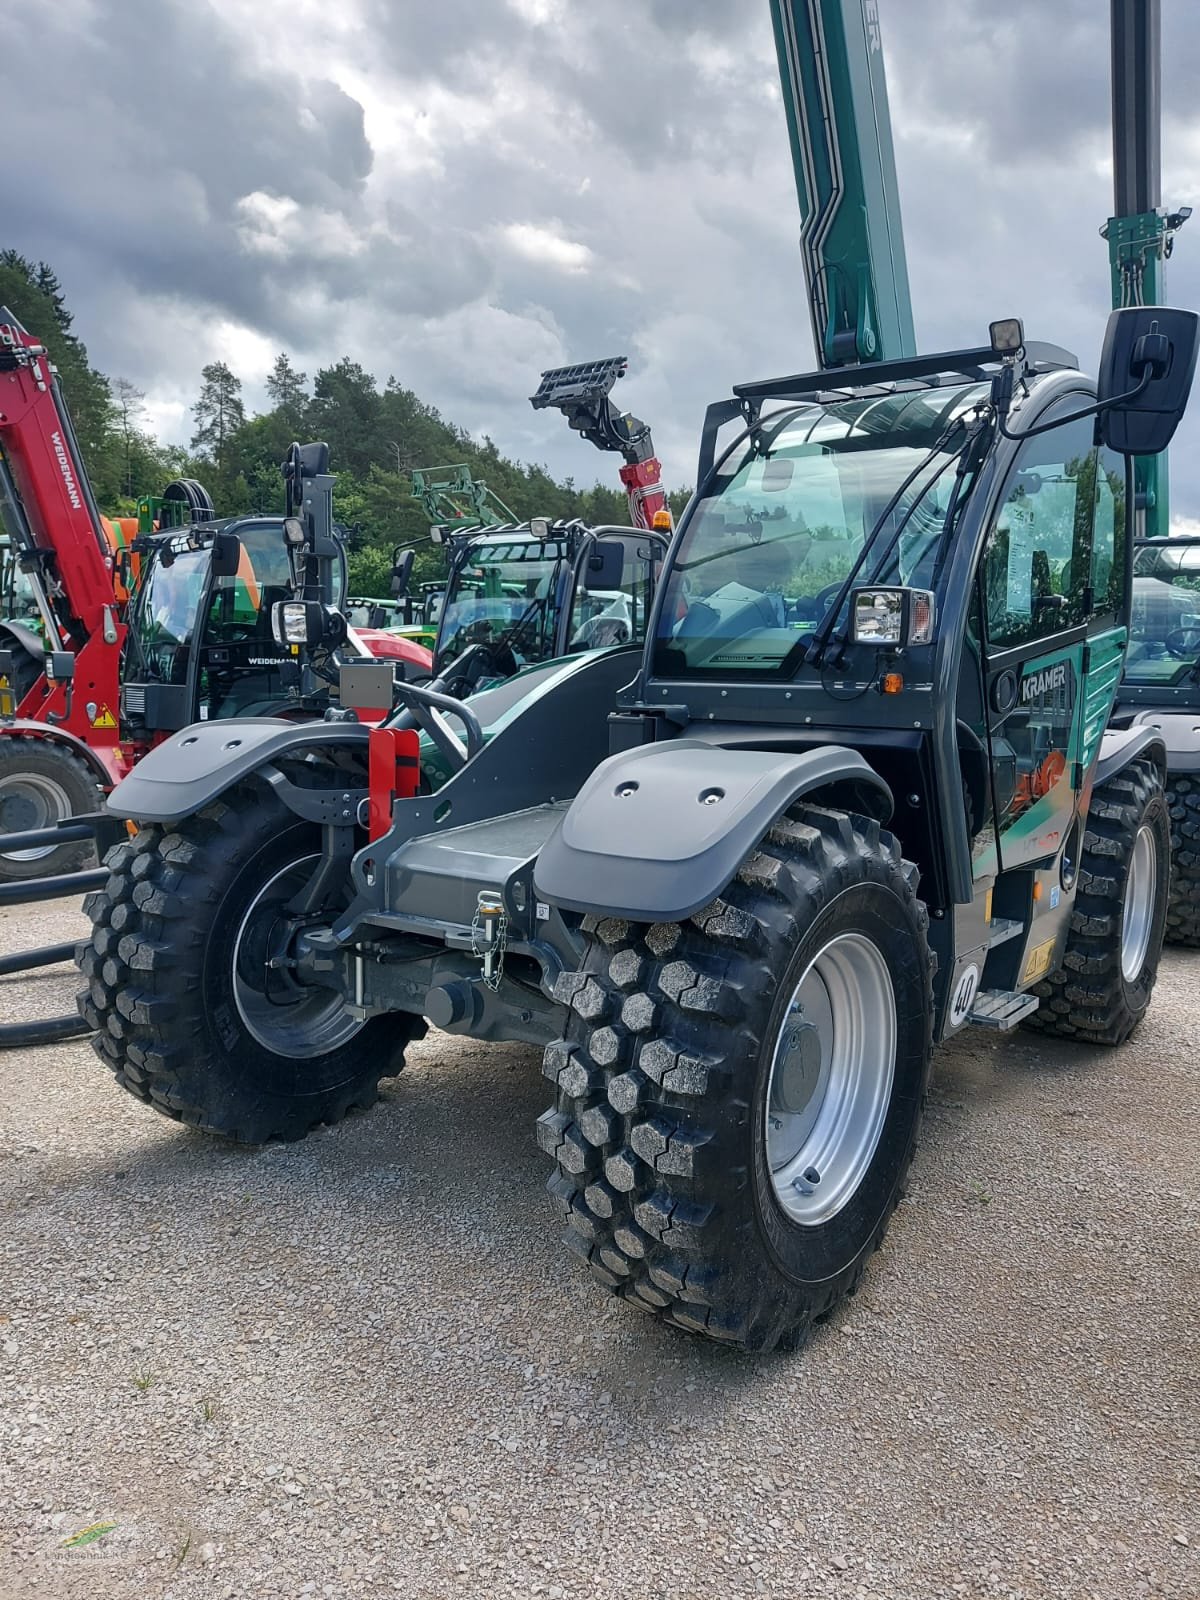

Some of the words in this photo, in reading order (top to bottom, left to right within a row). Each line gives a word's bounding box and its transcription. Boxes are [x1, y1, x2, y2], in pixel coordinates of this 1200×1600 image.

[51, 431, 81, 509] WEIDEMANN
[1022, 665, 1066, 702] KRAMER
[954, 974, 974, 1017] 40
